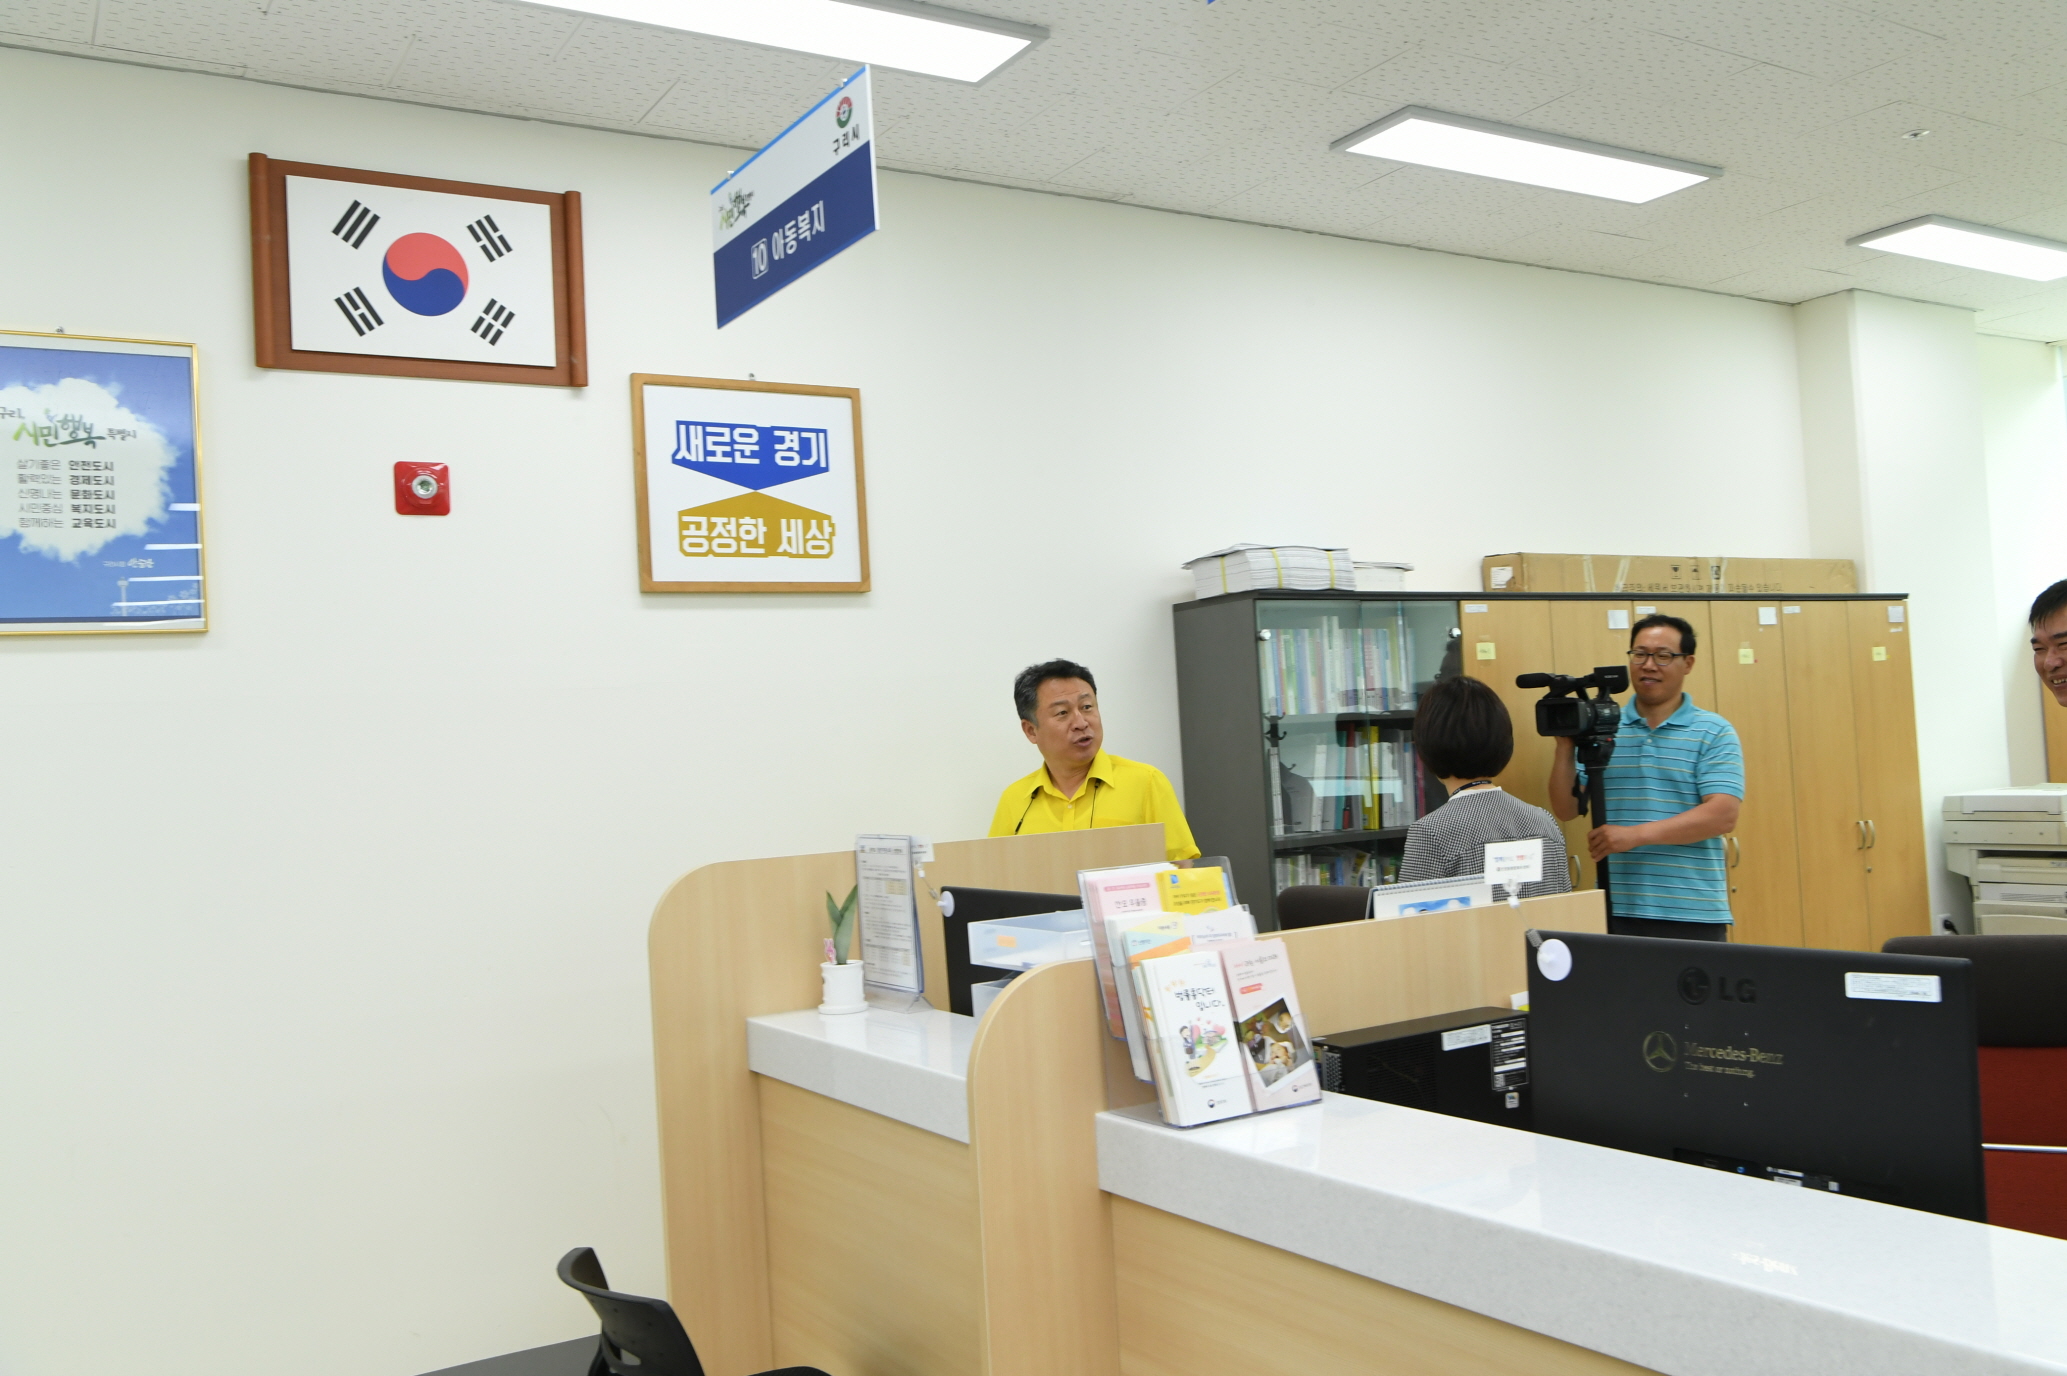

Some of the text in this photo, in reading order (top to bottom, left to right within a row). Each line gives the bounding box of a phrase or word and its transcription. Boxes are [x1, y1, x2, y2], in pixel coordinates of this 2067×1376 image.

[833, 123, 860, 156] 구리시
[752, 200, 825, 275] 10 아동복지
[106, 427, 137, 442] 특별시
[674, 424, 828, 468] 새로운 경기
[17, 459, 114, 472] 살기좋은 안전도시
[69, 474, 115, 486] 경제도시
[70, 489, 115, 500] 문화도시
[18, 502, 116, 515] 시민중심 복지도시
[18, 517, 117, 529] 함께하는 교육도시
[681, 516, 834, 555] 공정한 세상
[1719, 976, 1758, 1004] LG
[1683, 1041, 1784, 1065] Mercedes-Benz
